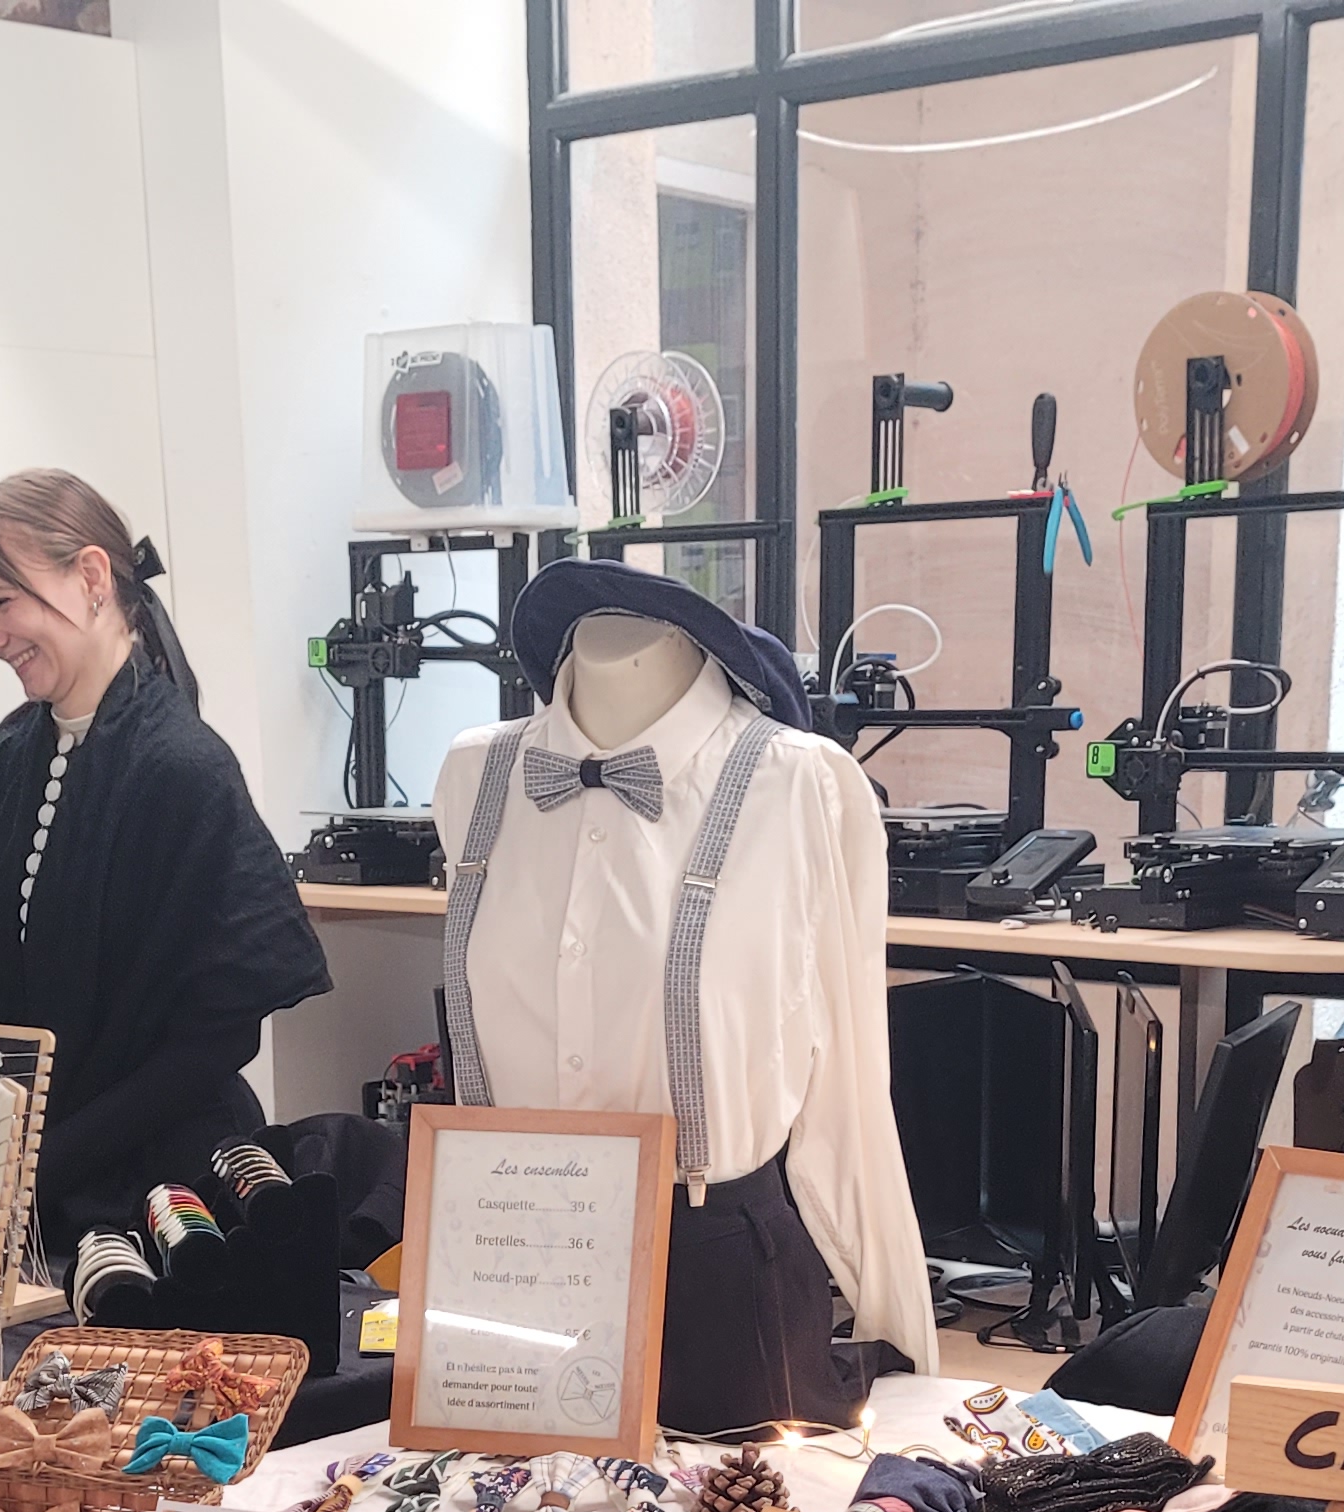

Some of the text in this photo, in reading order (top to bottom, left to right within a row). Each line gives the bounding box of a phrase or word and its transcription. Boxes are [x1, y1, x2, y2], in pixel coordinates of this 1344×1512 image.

[1091, 745, 1099, 764] 8
[490, 1158, 589, 1177] Les ensembles
[588, 1201, 597, 1213] €
[1286, 1216, 1311, 1232] Les
[586, 1238, 595, 1250] €
[1302, 1249, 1327, 1260] vous
[583, 1275, 592, 1287] €
[1277, 1284, 1291, 1295] Les
[1290, 1305, 1304, 1316] des
[583, 1328, 591, 1341] €
[1289, 1324, 1313, 1336] partir
[1314, 1327, 1325, 1338] de
[1248, 1339, 1283, 1353] garantis
[1284, 1345, 1309, 1360] 100%
[498, 1366, 514, 1376] pas
[442, 1379, 538, 1393] demander pour toute
